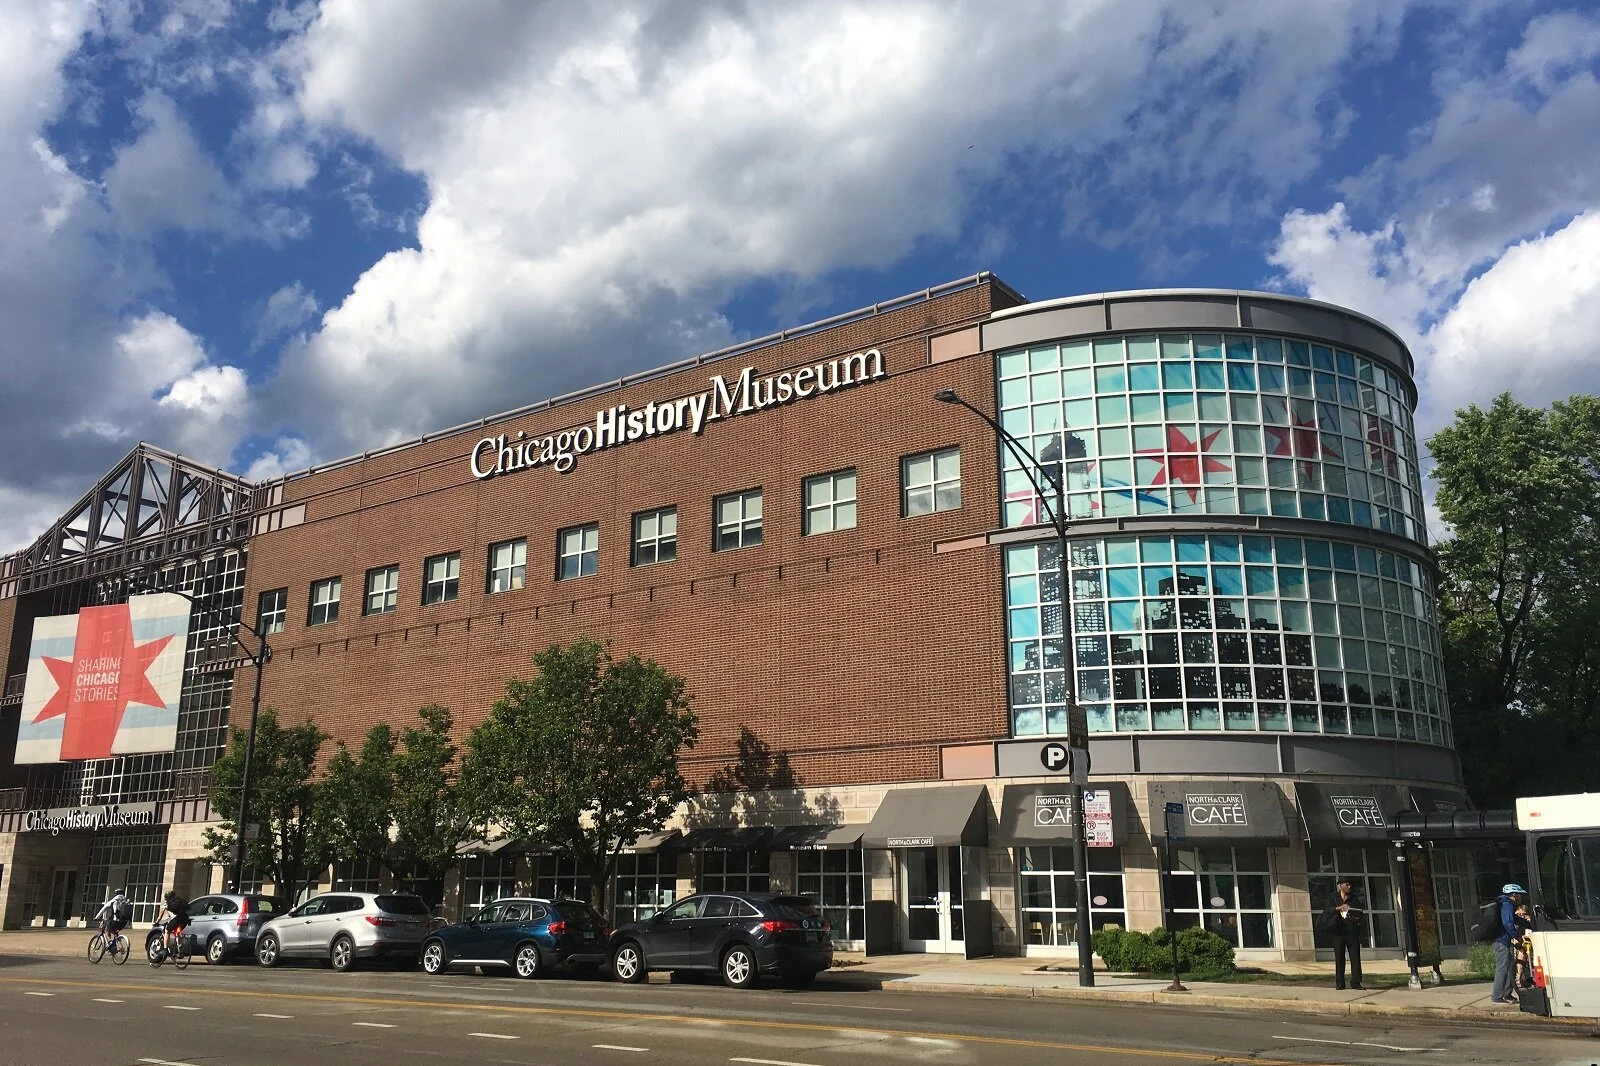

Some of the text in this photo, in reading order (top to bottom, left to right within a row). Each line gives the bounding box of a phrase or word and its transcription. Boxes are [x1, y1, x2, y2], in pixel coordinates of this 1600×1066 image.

[1047, 747, 1065, 767] P
[1037, 797, 1072, 805] NORTH&CL
[1188, 796, 1241, 804] NORTH&CLARK
[1037, 807, 1072, 825] CAF
[1191, 803, 1245, 824] CAFÉ
[1339, 806, 1383, 826] CAFÉ
